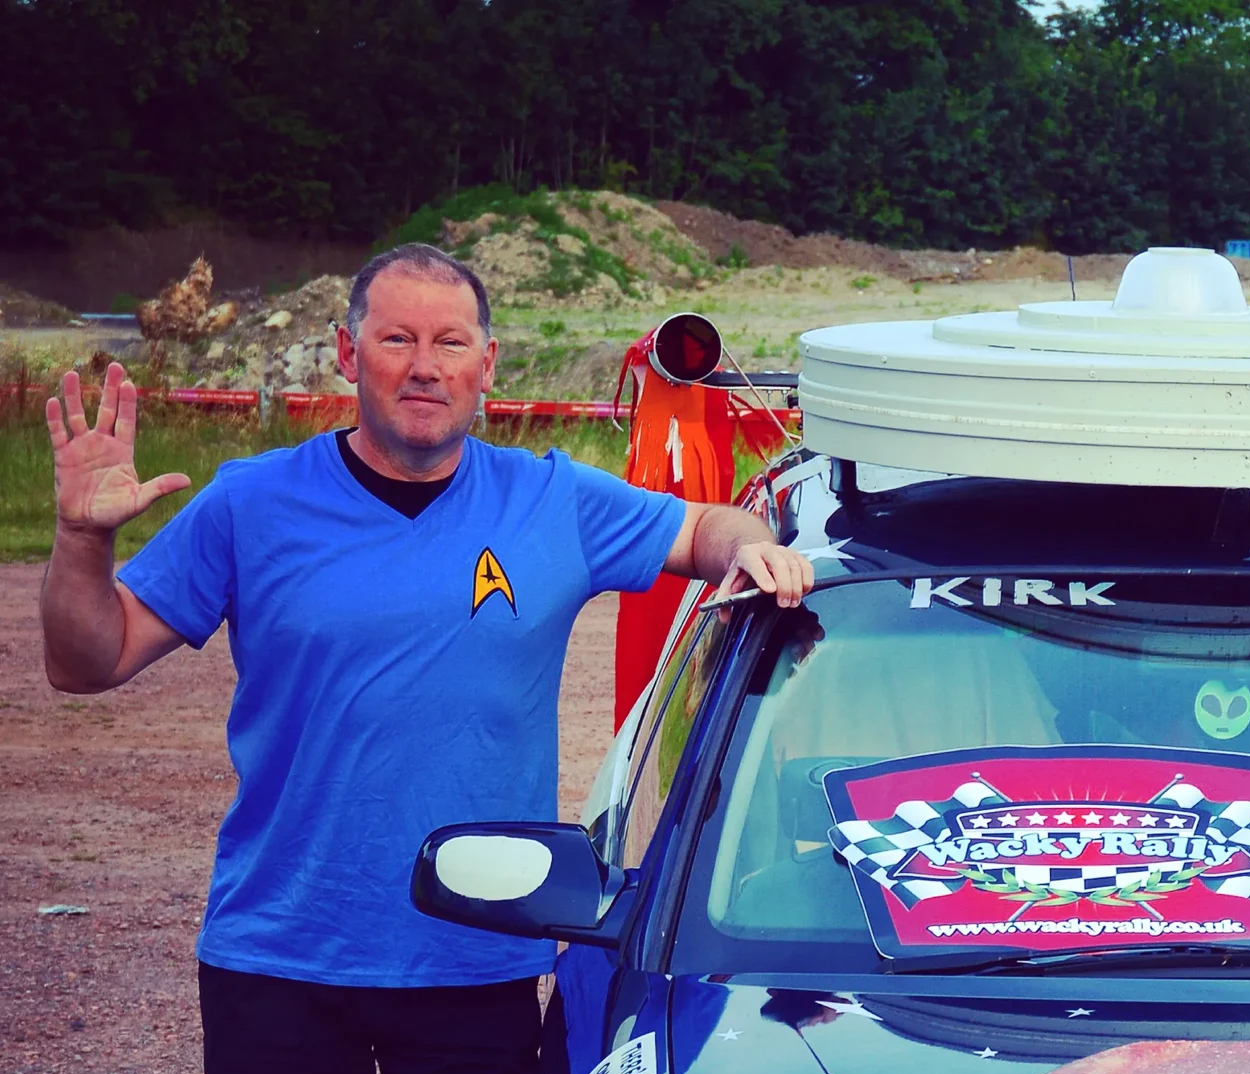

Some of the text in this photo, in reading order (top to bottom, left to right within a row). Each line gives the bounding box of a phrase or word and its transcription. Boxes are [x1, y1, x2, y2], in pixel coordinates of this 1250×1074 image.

[910, 577, 1116, 608] KIRK
[918, 831, 1243, 867] Wacky Rally
[928, 917, 1245, 938] www.wackyrally.co.uk
